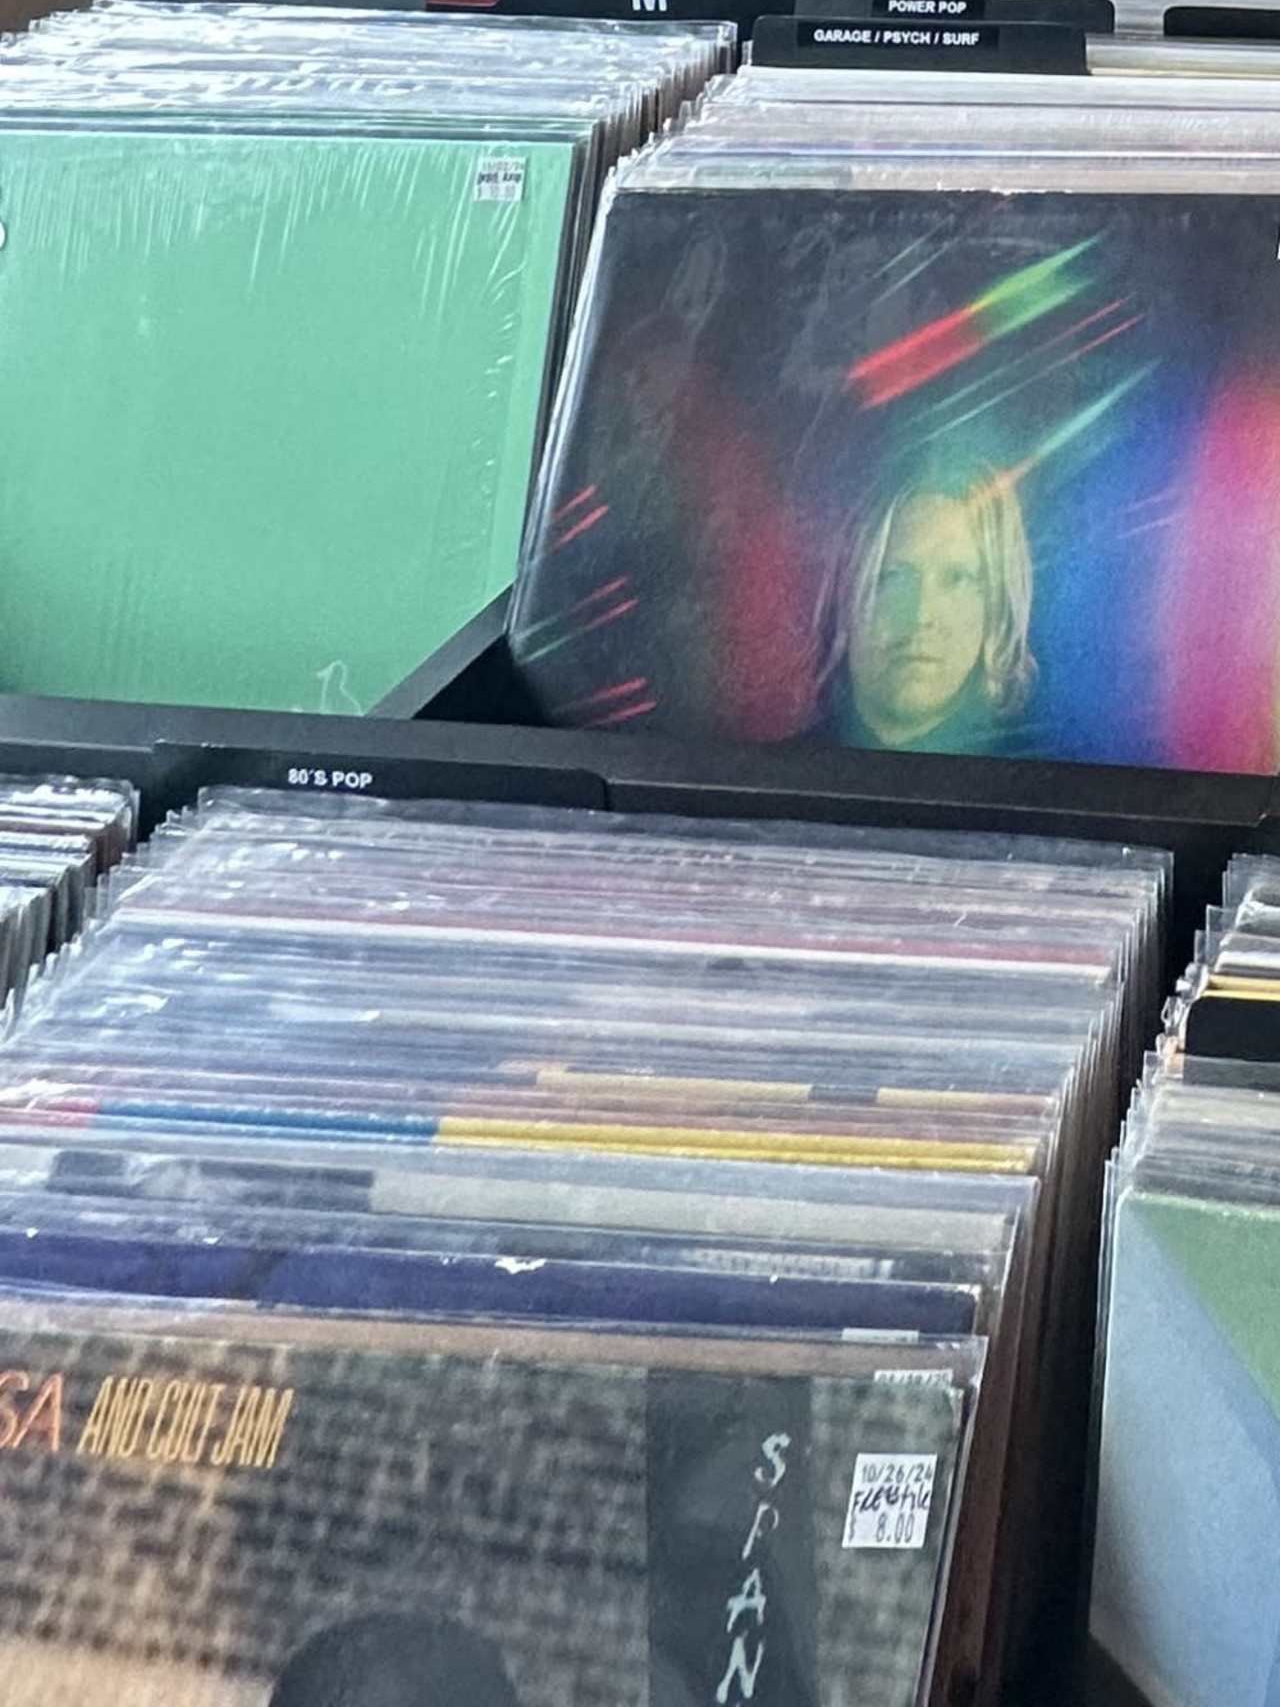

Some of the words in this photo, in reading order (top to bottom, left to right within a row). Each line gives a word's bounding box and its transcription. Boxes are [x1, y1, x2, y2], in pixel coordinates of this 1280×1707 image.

[888, 0, 935, 13] POWER
[938, 2, 966, 14] POP
[814, 29, 872, 42] GARAGE
[883, 31, 931, 44] PSYCH
[942, 33, 979, 45] SURF
[331, 771, 373, 788] POP
[76, 1375, 153, 1458] AND
[210, 1385, 294, 1470] JAM
[861, 1463, 935, 1484] 10/26/24
[876, 1513, 915, 1544] 8.00
